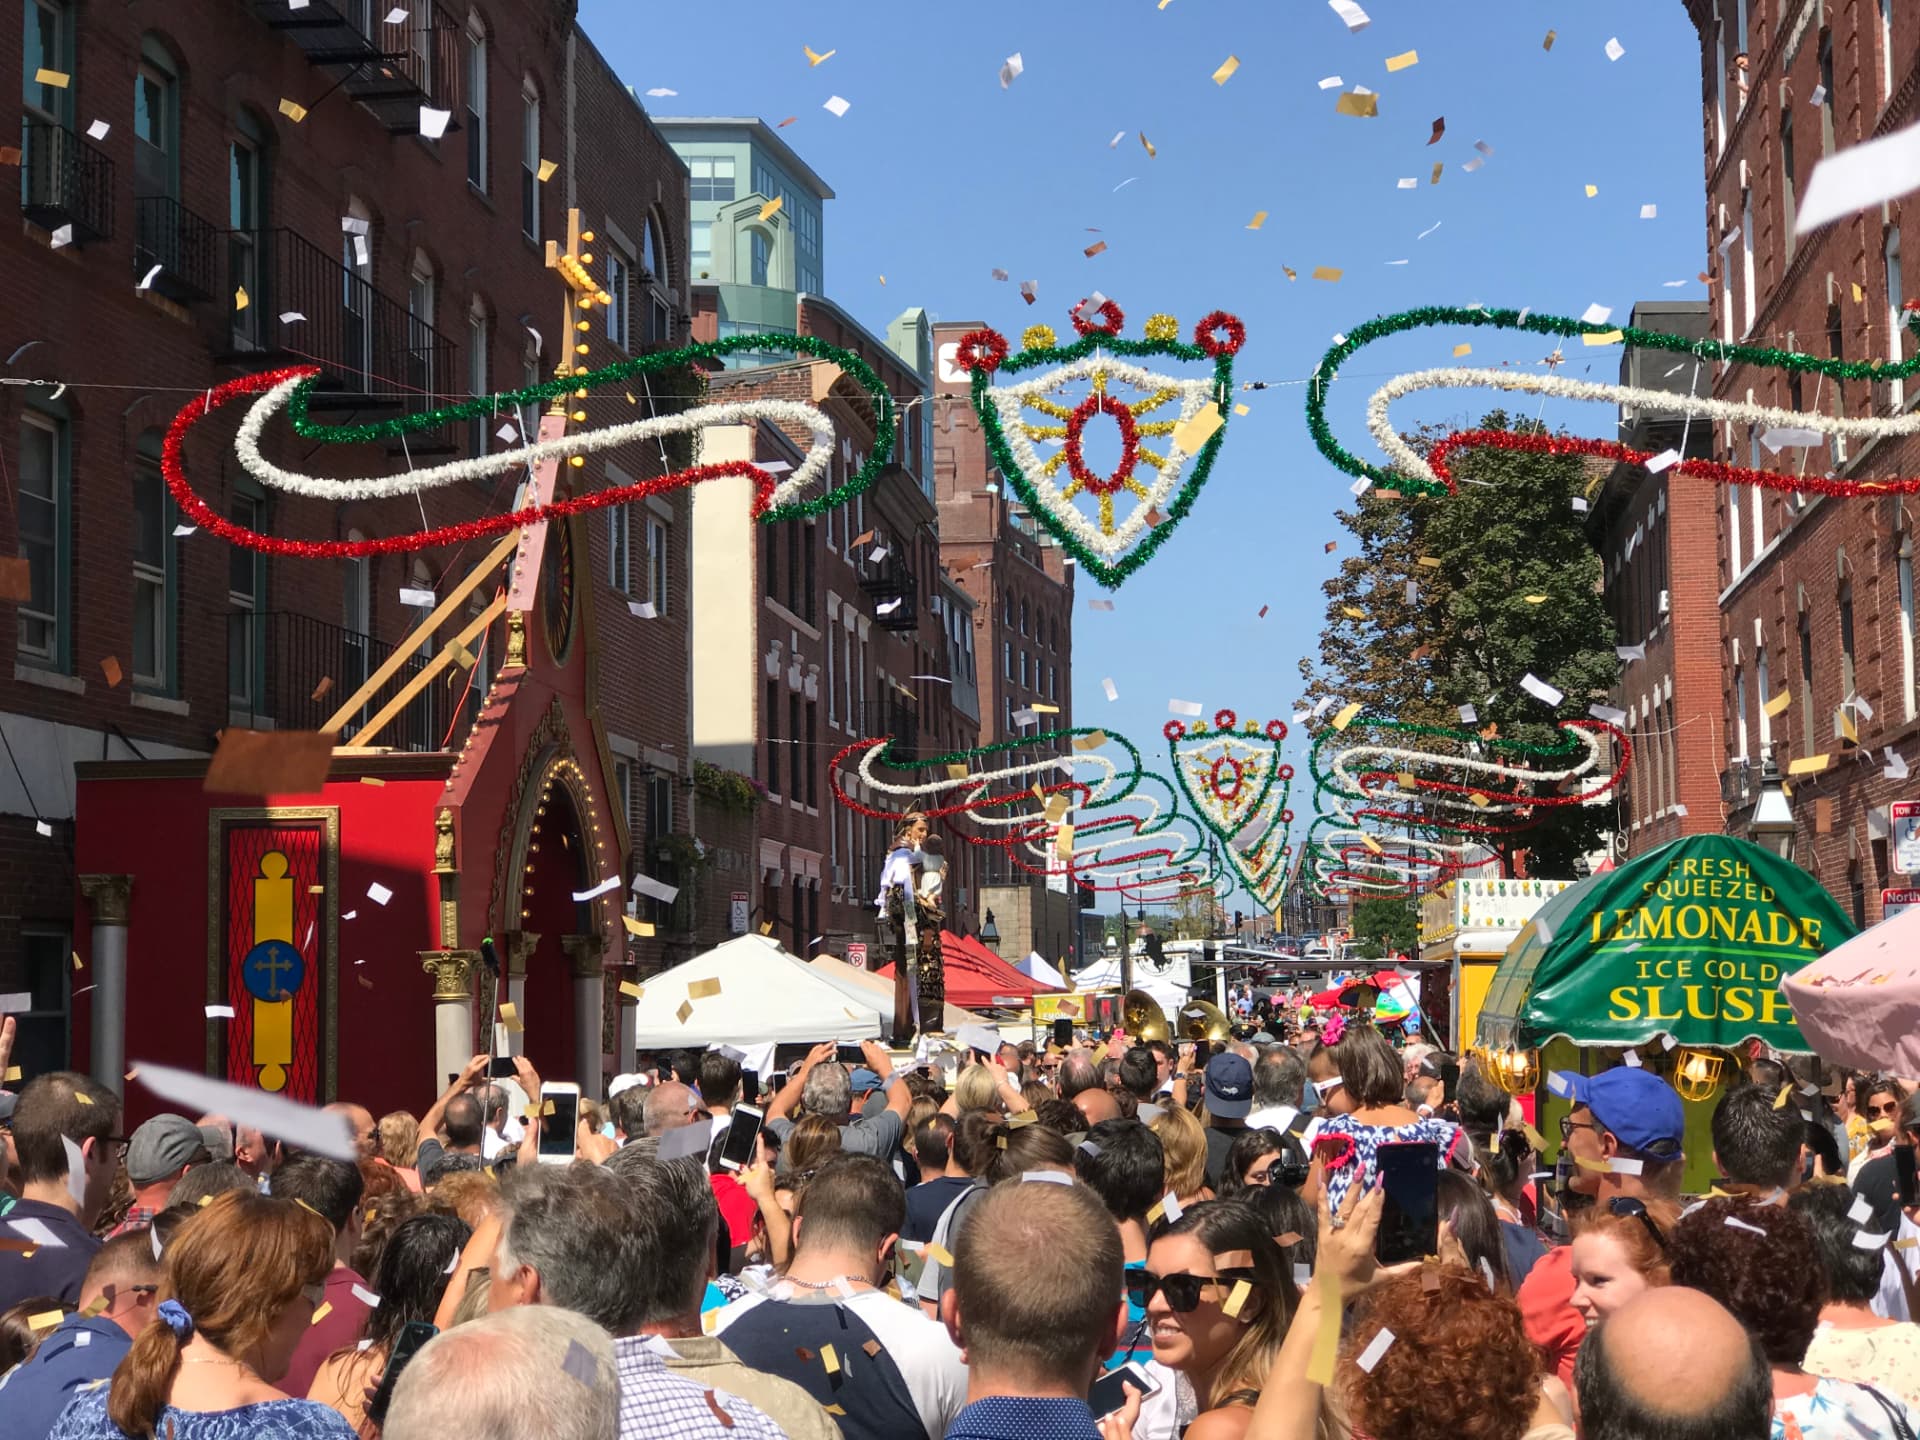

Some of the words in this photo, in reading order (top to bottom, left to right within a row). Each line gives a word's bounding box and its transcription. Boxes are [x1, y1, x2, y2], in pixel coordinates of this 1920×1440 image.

[1894, 806, 1911, 817] TOW
[1667, 858, 1750, 879] FRESH
[1642, 879, 1775, 902] SQUEEZED
[1589, 904, 1825, 949] LEMONADE
[1636, 959, 1693, 979] ICE
[1704, 959, 1778, 982] COLD
[1608, 985, 1798, 1025] SLUSH
